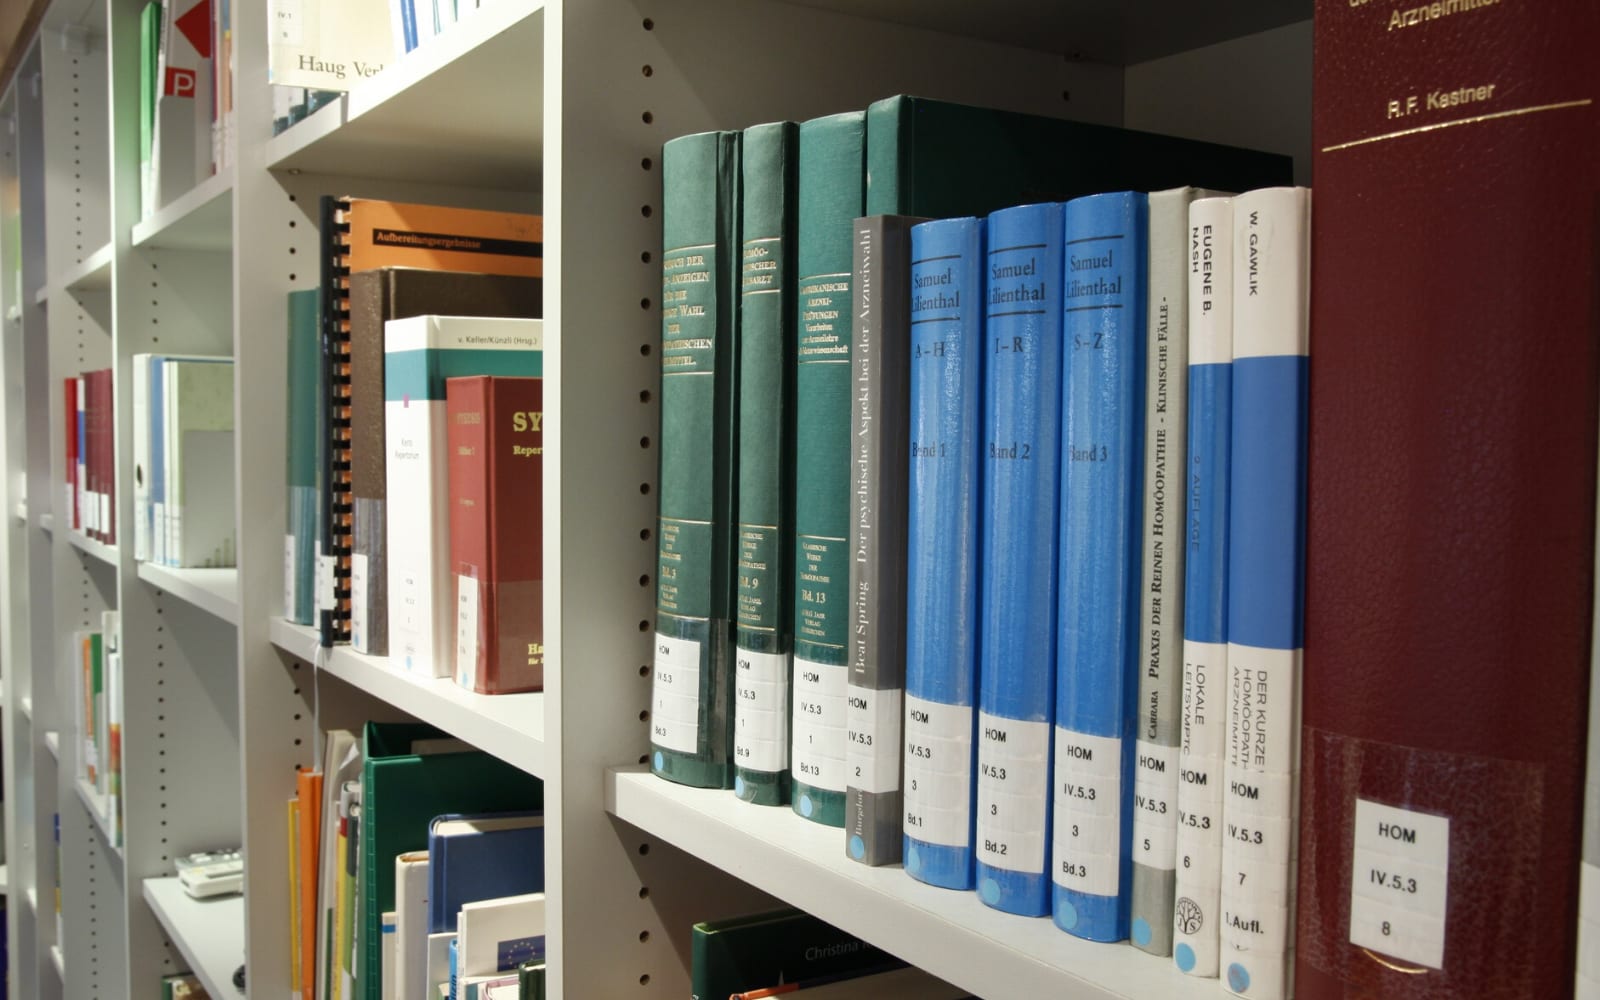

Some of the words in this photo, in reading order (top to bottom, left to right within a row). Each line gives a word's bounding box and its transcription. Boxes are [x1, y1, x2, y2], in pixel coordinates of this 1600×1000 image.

[298, 54, 346, 80] Haug
[174, 73, 194, 97] P
[1427, 84, 1496, 110] Kastner
[992, 257, 1035, 280] Samuel
[1070, 249, 1113, 272] Samuel
[1203, 225, 1212, 296] EUGENE
[1249, 233, 1258, 297] GAWLIK
[859, 229, 872, 321] Arzneiwahl
[914, 267, 952, 289] Samuel
[988, 283, 1045, 305] Lilienthal
[1066, 276, 1121, 299] Lilienthal
[912, 291, 960, 312] Lilienthal
[1202, 301, 1212, 316] B.
[1157, 303, 1169, 342] FÄLLE
[859, 329, 871, 353] der
[858, 359, 870, 381] bei
[1157, 345, 1168, 414] KLINISCHE
[858, 387, 872, 436] Aspekt
[940, 442, 945, 458] 1
[989, 441, 1017, 460] Band
[1022, 444, 1030, 460] 2
[1100, 445, 1108, 462] 3
[857, 444, 871, 529] psychische
[1153, 429, 1166, 536] HOMÖOPATHIE
[856, 532, 868, 563] Der
[1151, 540, 1163, 594] REINEN
[752, 578, 759, 590] 9
[816, 592, 826, 605] 13
[856, 581, 870, 635] Spring
[1151, 597, 1162, 626] DER
[659, 645, 670, 655] HOM
[855, 640, 866, 673] Beat
[1148, 629, 1161, 679] PRAXIS
[738, 659, 751, 671] HOM
[803, 672, 820, 683] HOM
[1195, 664, 1206, 725] LOKALE
[1256, 670, 1268, 705] DER
[801, 703, 822, 715] IV.5.3
[848, 697, 867, 710] HOM
[910, 709, 929, 724] HOM
[1148, 690, 1159, 739] CARRARA
[848, 731, 873, 746] IV.5.3
[985, 728, 1007, 743] HOM
[1255, 709, 1267, 765] KURZE
[736, 746, 750, 758] Bd.9
[908, 743, 931, 760] IV.5.3
[1067, 745, 1092, 761] HOM
[800, 762, 820, 776] Bd.13
[855, 767, 861, 777] 2
[981, 764, 1006, 780] IV.5.3
[1139, 756, 1165, 773] HOM
[912, 780, 917, 791] 3
[1181, 768, 1207, 786] HOM
[1064, 783, 1096, 801] IV.5.3
[1231, 781, 1258, 800] HOM
[991, 804, 997, 816] 3
[1135, 795, 1167, 813] IV.5.3
[907, 813, 923, 827] Bd.1
[1177, 809, 1211, 830] V.5.3
[1072, 825, 1079, 837] 3
[1228, 823, 1263, 845] IV.5.3
[1378, 821, 1417, 844] HOM
[985, 840, 1007, 856] Bd.2
[1143, 839, 1151, 851] 5
[1062, 861, 1086, 878] Bd.3
[1183, 855, 1190, 868] 6
[1238, 872, 1246, 886] 7
[1370, 869, 1418, 894] IV.5.3
[1382, 921, 1391, 936] 8
[805, 941, 858, 960] Christina
